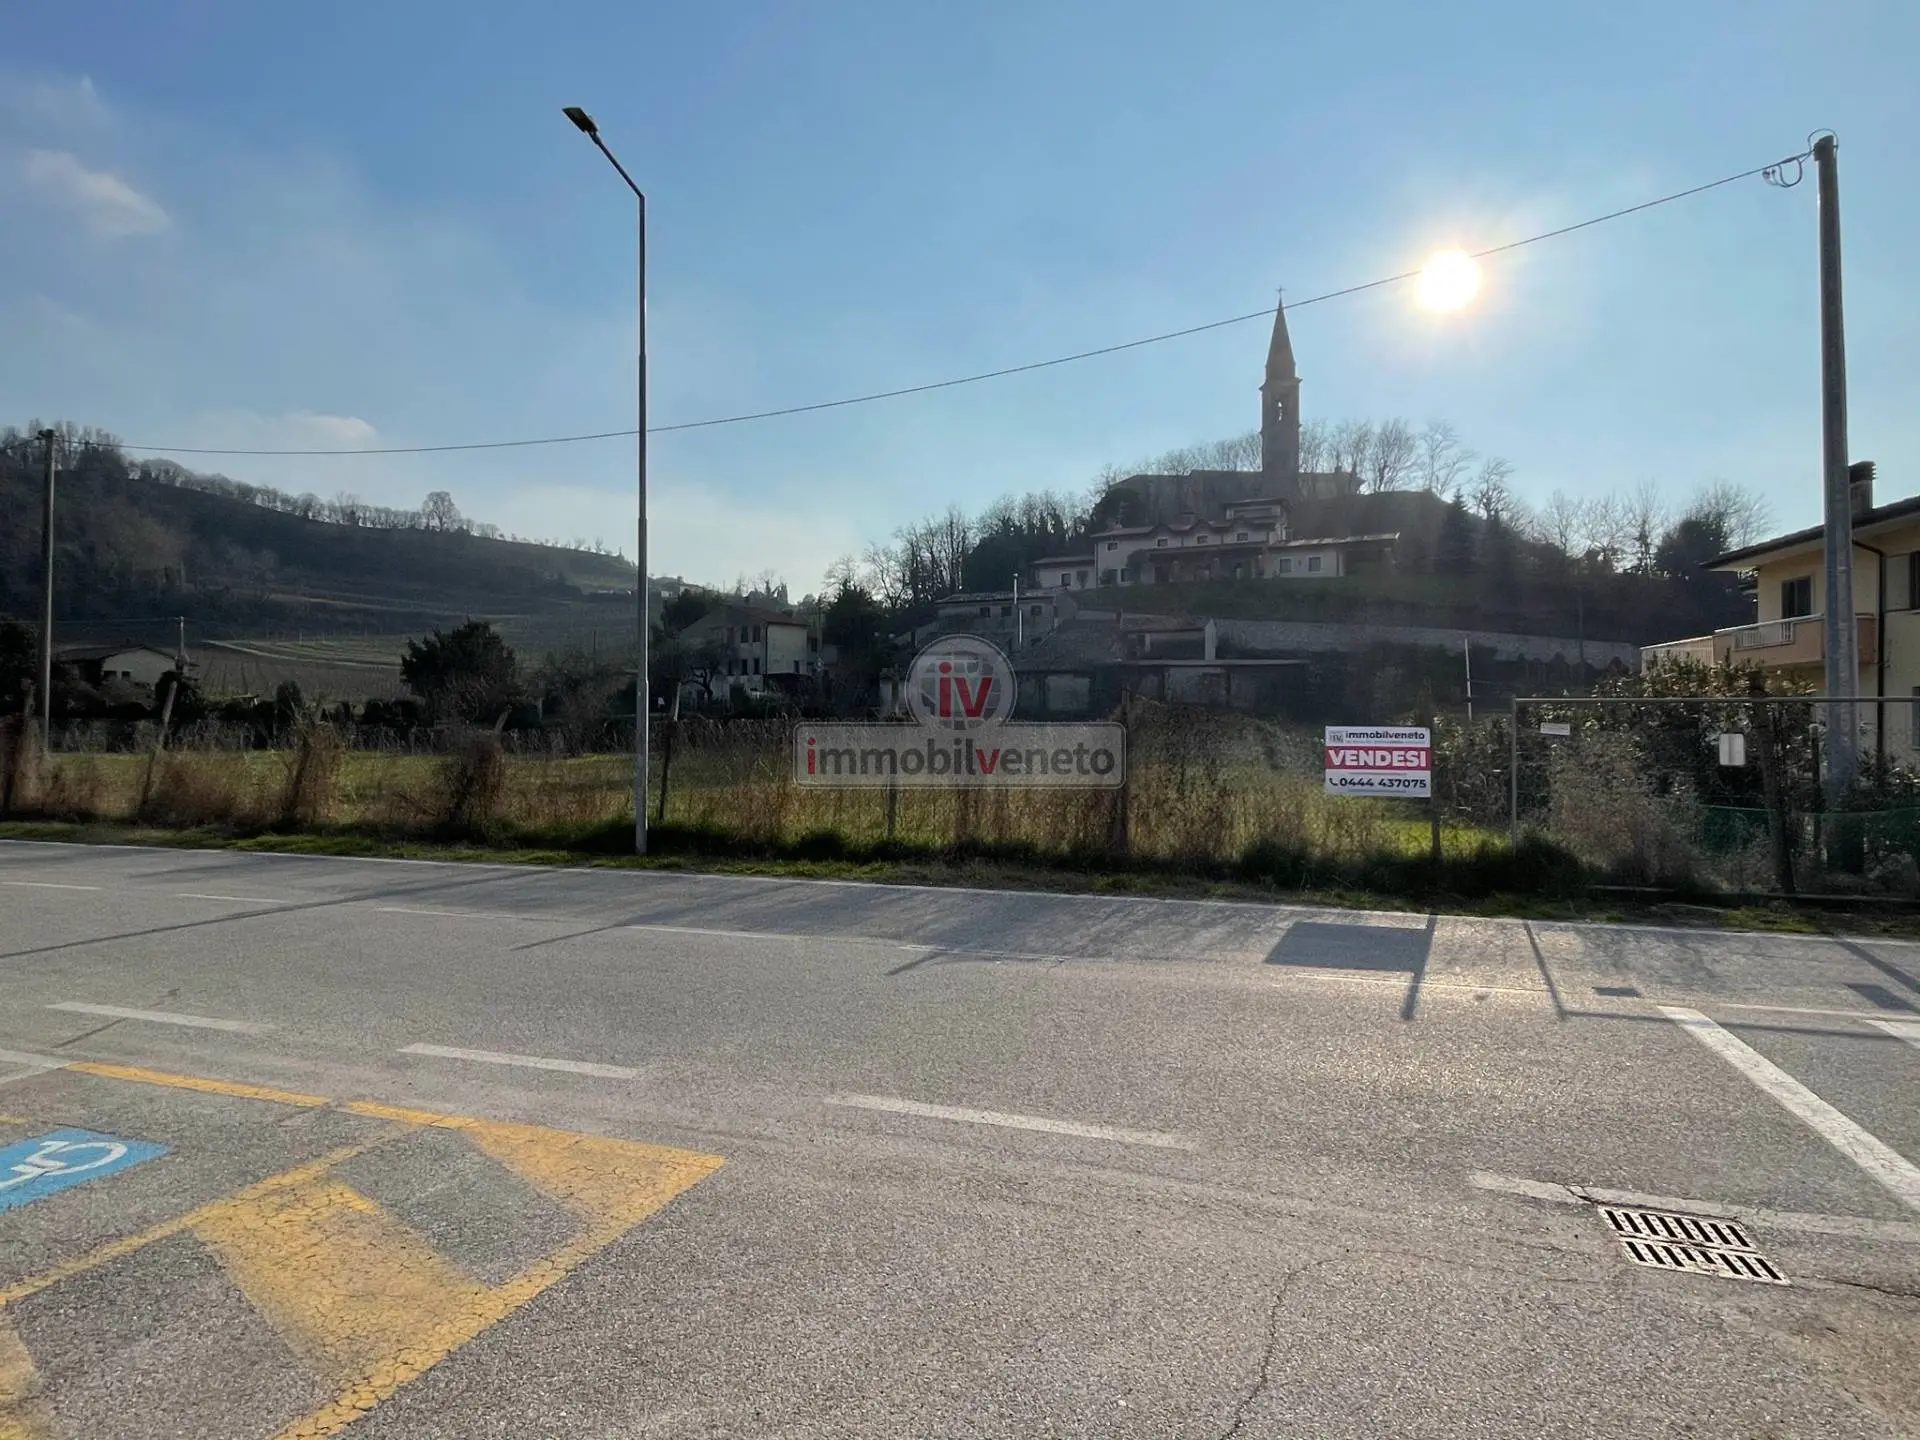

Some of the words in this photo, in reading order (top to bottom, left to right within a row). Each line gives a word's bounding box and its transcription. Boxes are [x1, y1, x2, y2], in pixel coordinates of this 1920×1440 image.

[1345, 730, 1425, 740] immobilveneto
[1328, 749, 1427, 767] VENDESI
[1339, 777, 1374, 787] 0444
[1378, 778, 1427, 788] 437075
